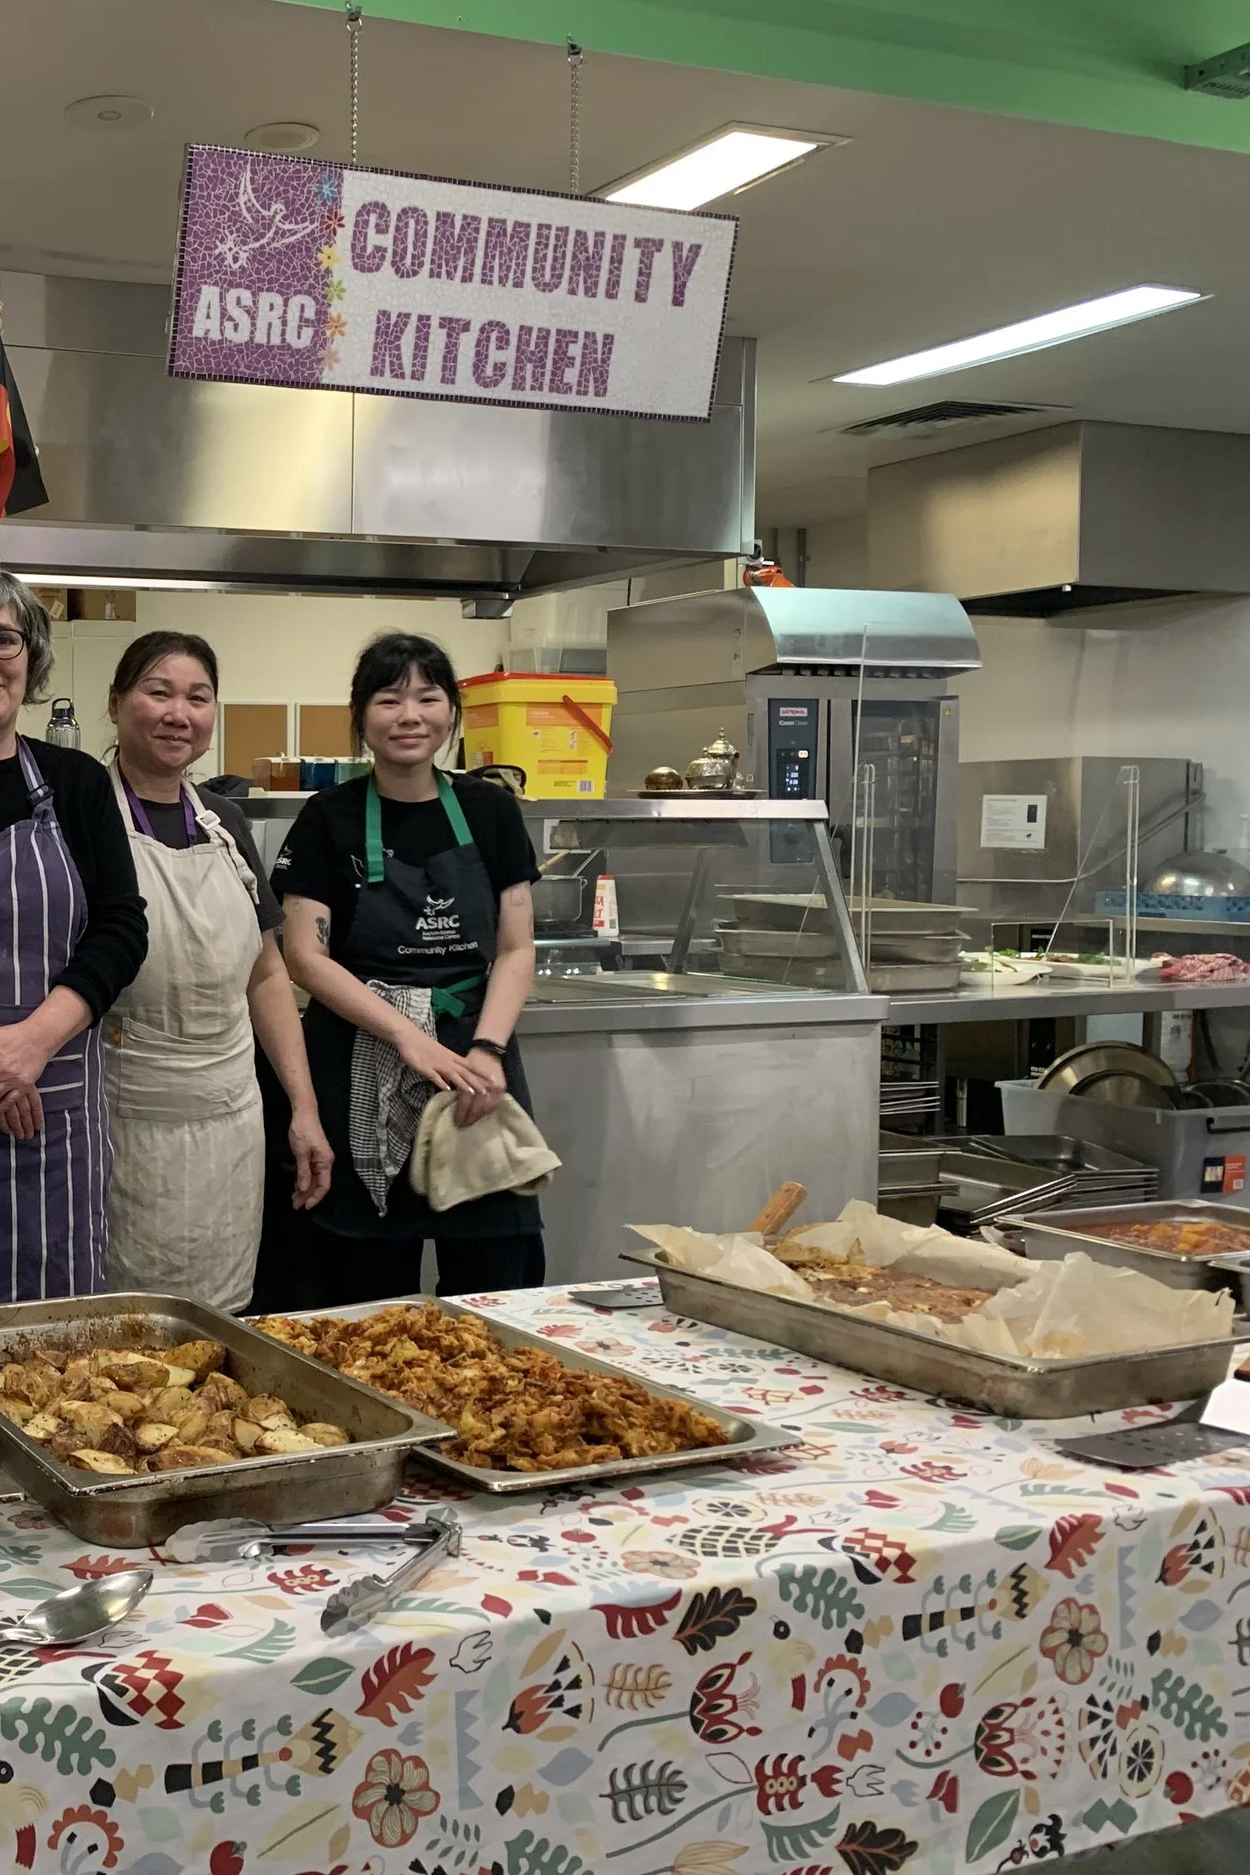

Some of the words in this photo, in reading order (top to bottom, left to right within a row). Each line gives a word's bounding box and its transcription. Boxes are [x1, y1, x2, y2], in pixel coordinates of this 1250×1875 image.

[350, 201, 703, 308] COMMUNITY
[192, 285, 317, 350] ASRC
[369, 310, 615, 398] KITCHEN
[276, 857, 292, 866] SRC
[415, 914, 460, 930] ASRC
[397, 945, 447, 956] Community
[448, 940, 479, 952] Kitchen
